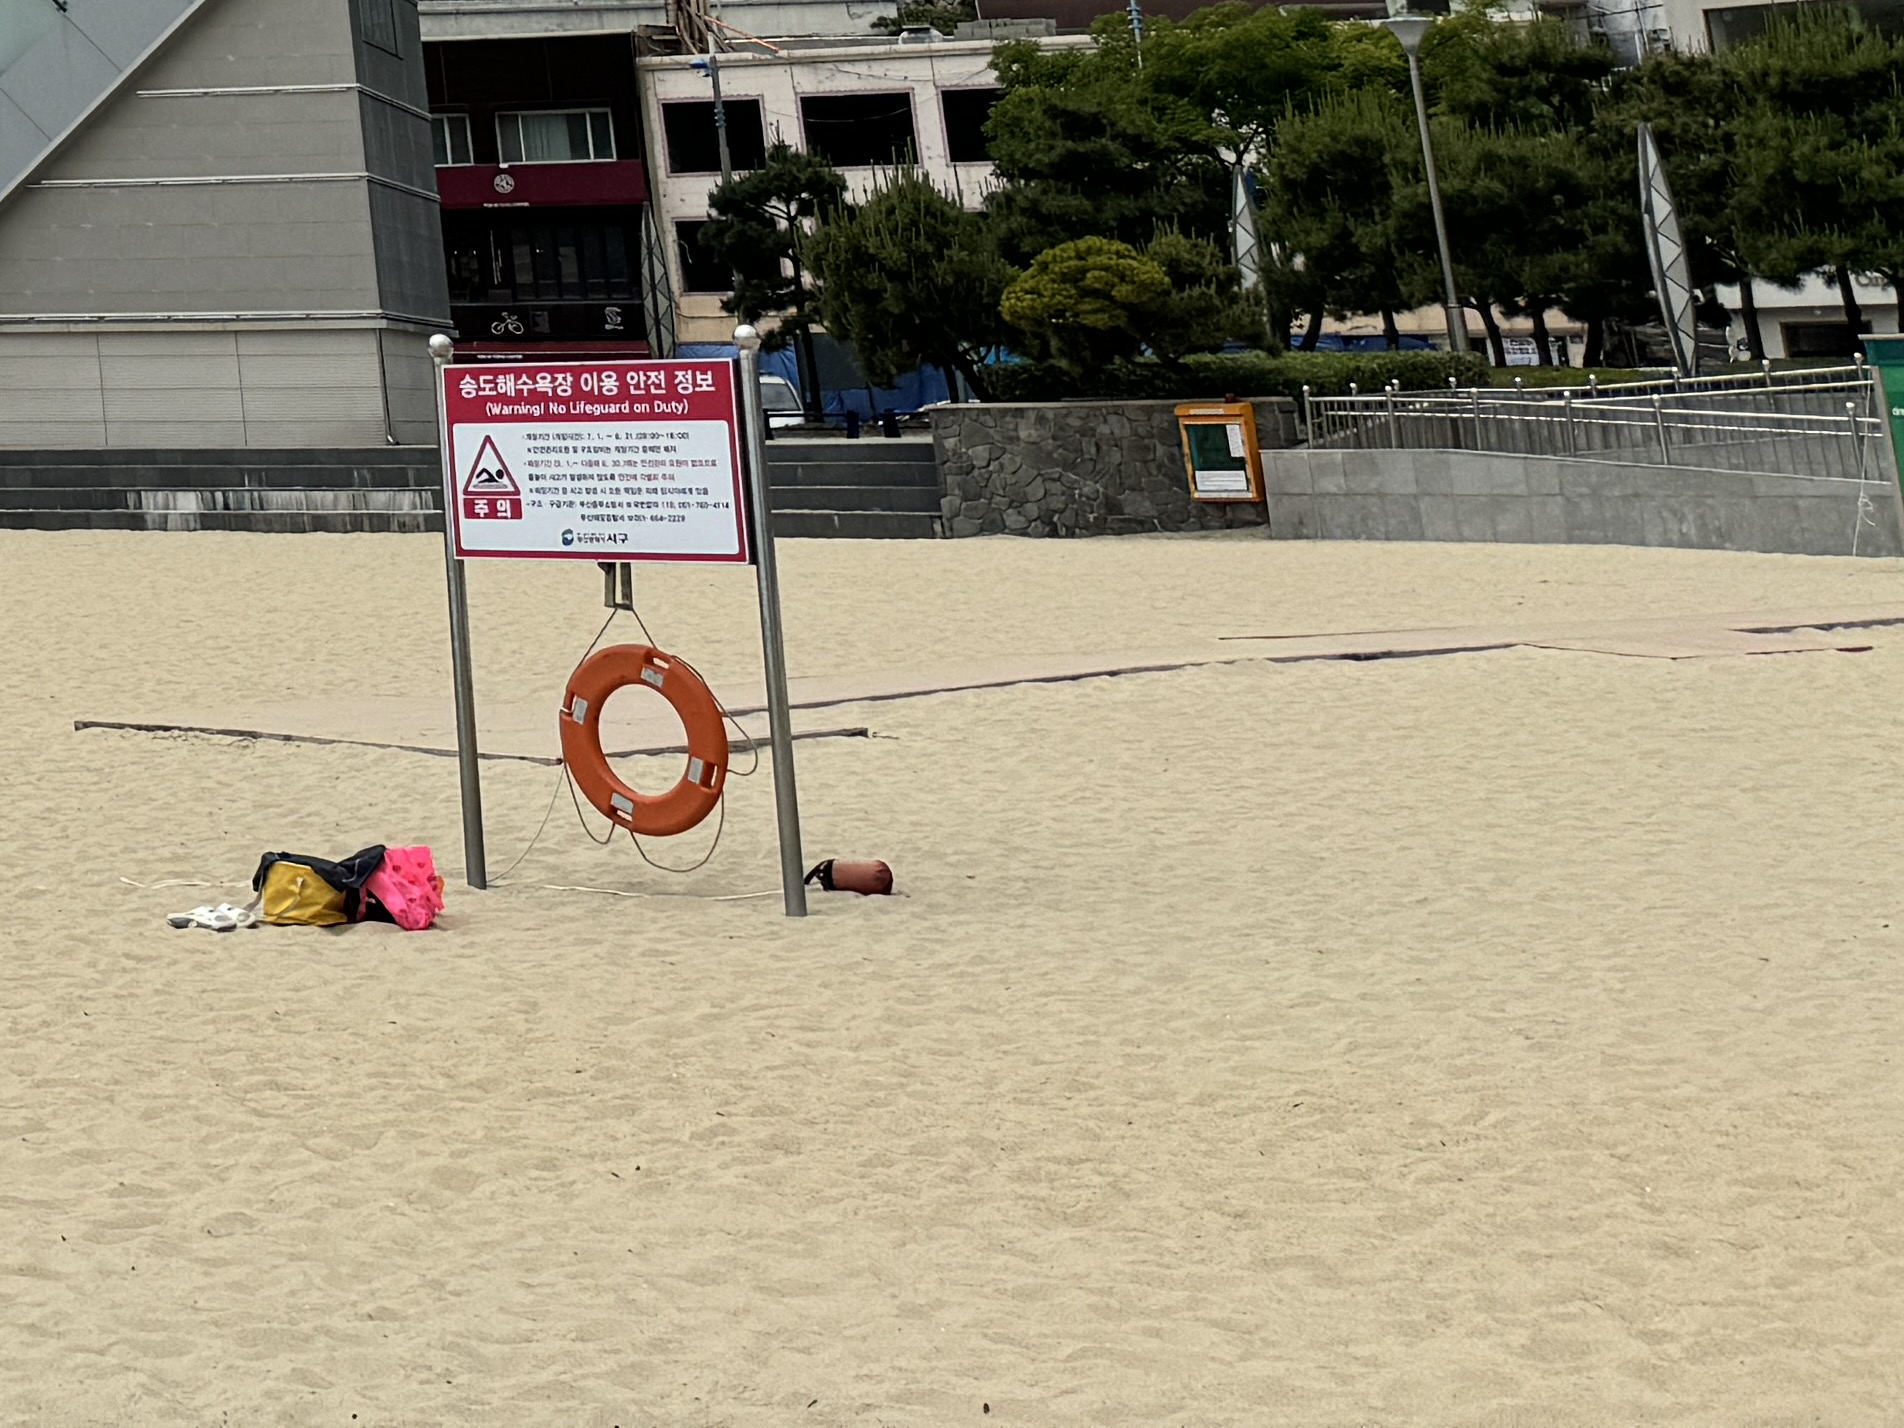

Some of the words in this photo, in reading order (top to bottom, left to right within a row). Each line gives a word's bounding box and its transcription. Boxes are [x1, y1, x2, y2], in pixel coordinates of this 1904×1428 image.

[459, 372, 573, 398] 송도해수욕장
[580, 371, 620, 396] 이용
[626, 370, 666, 395] 안전
[674, 370, 716, 395] 정보
[486, 401, 545, 417] (Warning!
[548, 401, 567, 415] No
[570, 400, 630, 416] Lifeguard
[633, 403, 650, 414] on
[654, 398, 689, 415] Duty)
